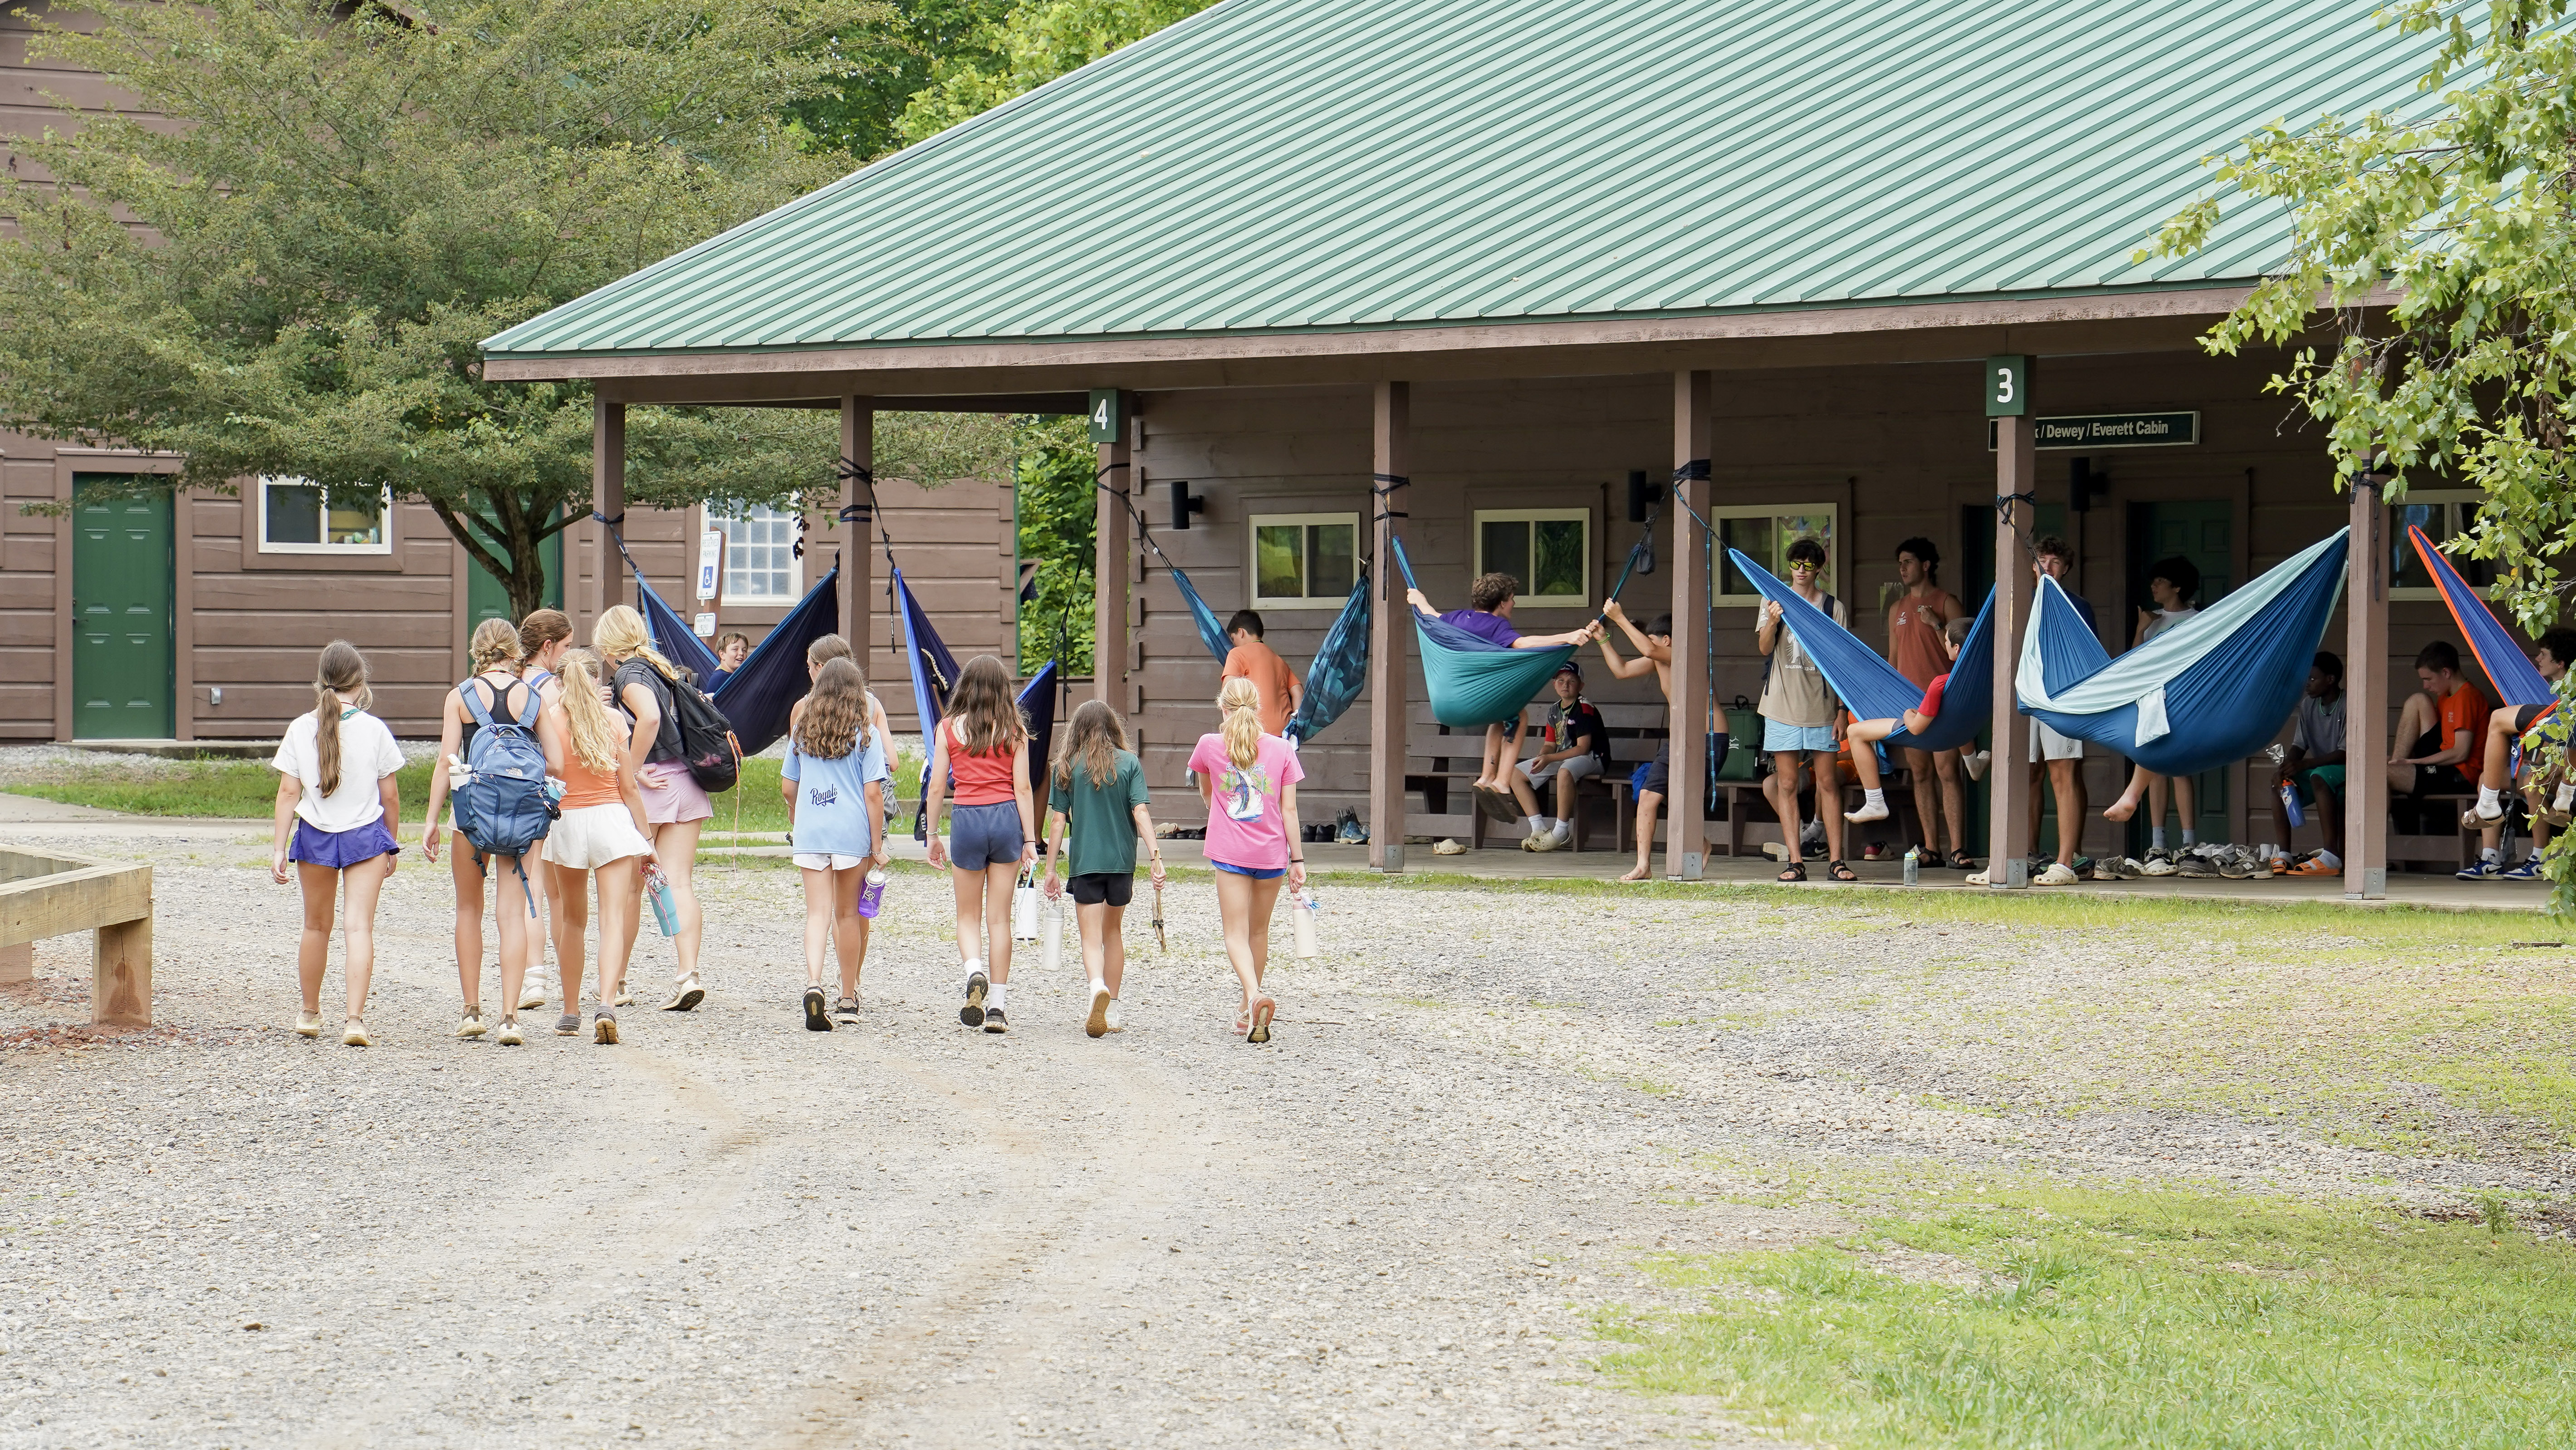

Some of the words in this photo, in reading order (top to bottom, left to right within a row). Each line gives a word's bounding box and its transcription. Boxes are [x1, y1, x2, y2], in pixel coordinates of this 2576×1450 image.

[1997, 368, 2013, 403] 3
[1094, 399, 1107, 430] 4
[2047, 425, 2085, 440] Dewey
[2092, 422, 2134, 436] Everett
[2136, 420, 2168, 435] Cabin
[810, 783, 837, 806] Royals
